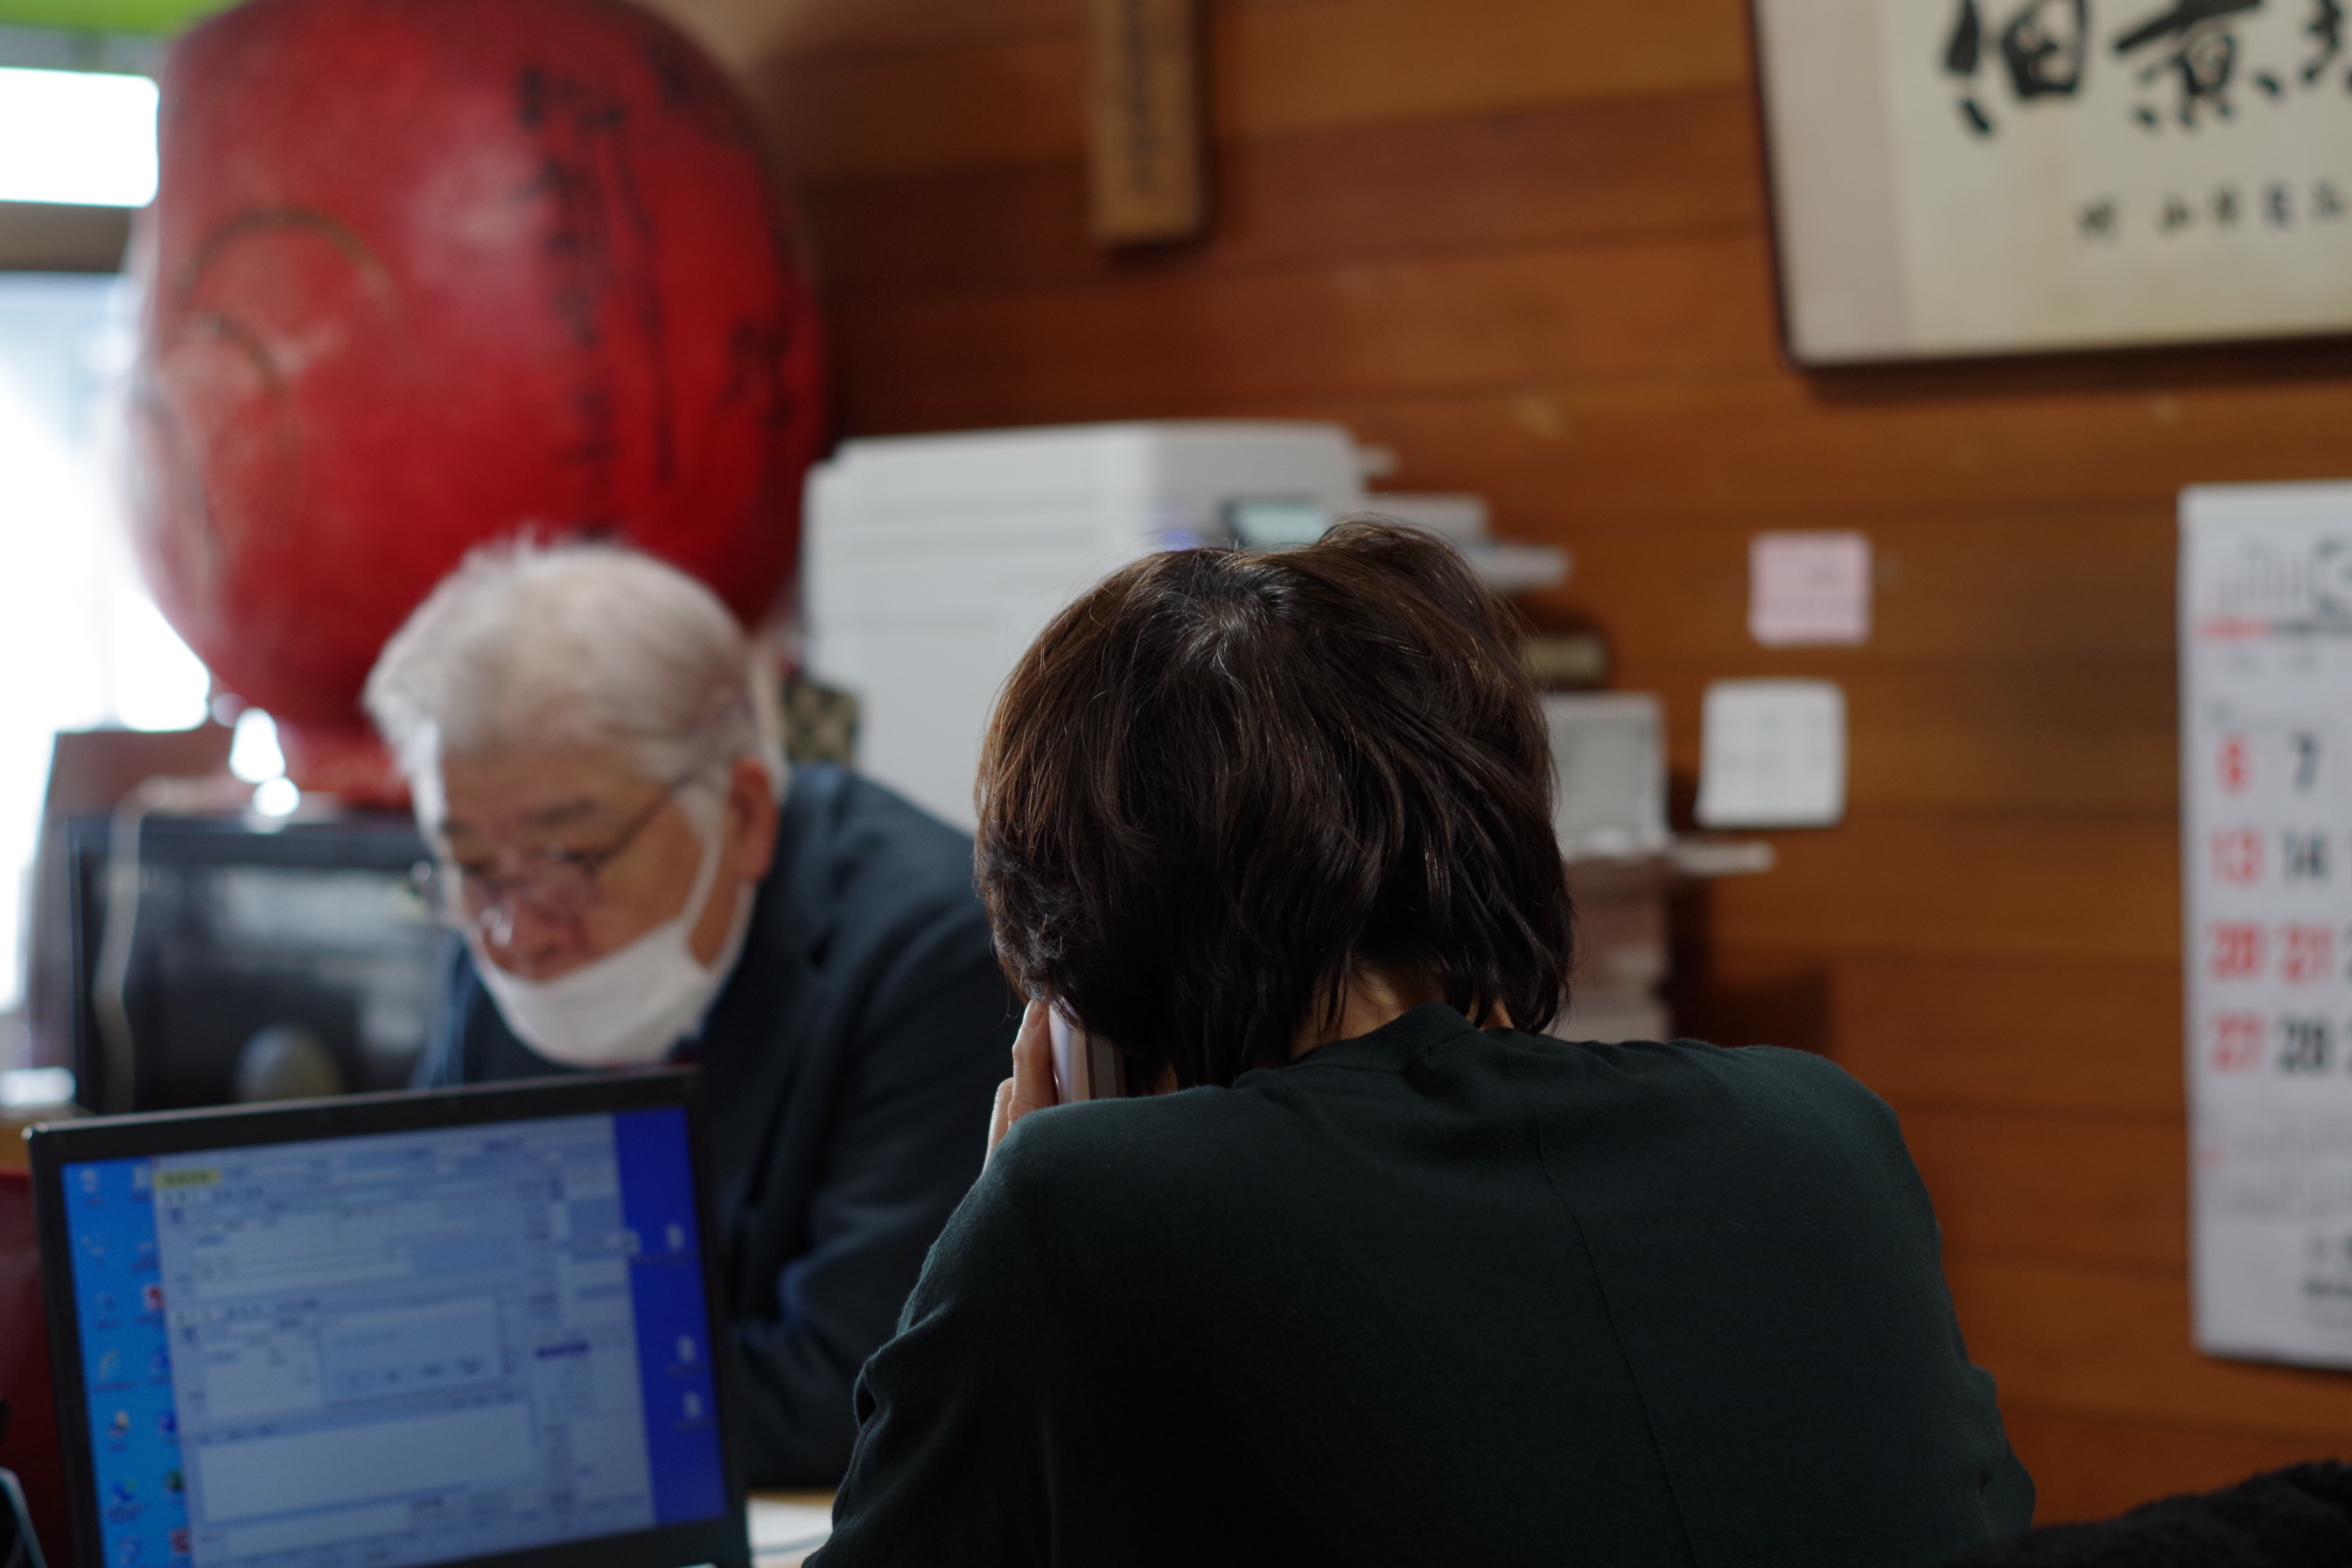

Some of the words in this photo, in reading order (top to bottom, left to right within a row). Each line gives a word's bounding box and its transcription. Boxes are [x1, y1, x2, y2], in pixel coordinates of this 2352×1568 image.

[2216, 734, 2251, 793] 6
[2290, 732, 2320, 792] 7
[2210, 827, 2263, 886] 13
[2283, 829, 2328, 887] 14
[2209, 922, 2263, 979] 20
[2283, 924, 2334, 982] 21
[2209, 1015, 2263, 1073] 27
[2279, 1016, 2334, 1075] 28
